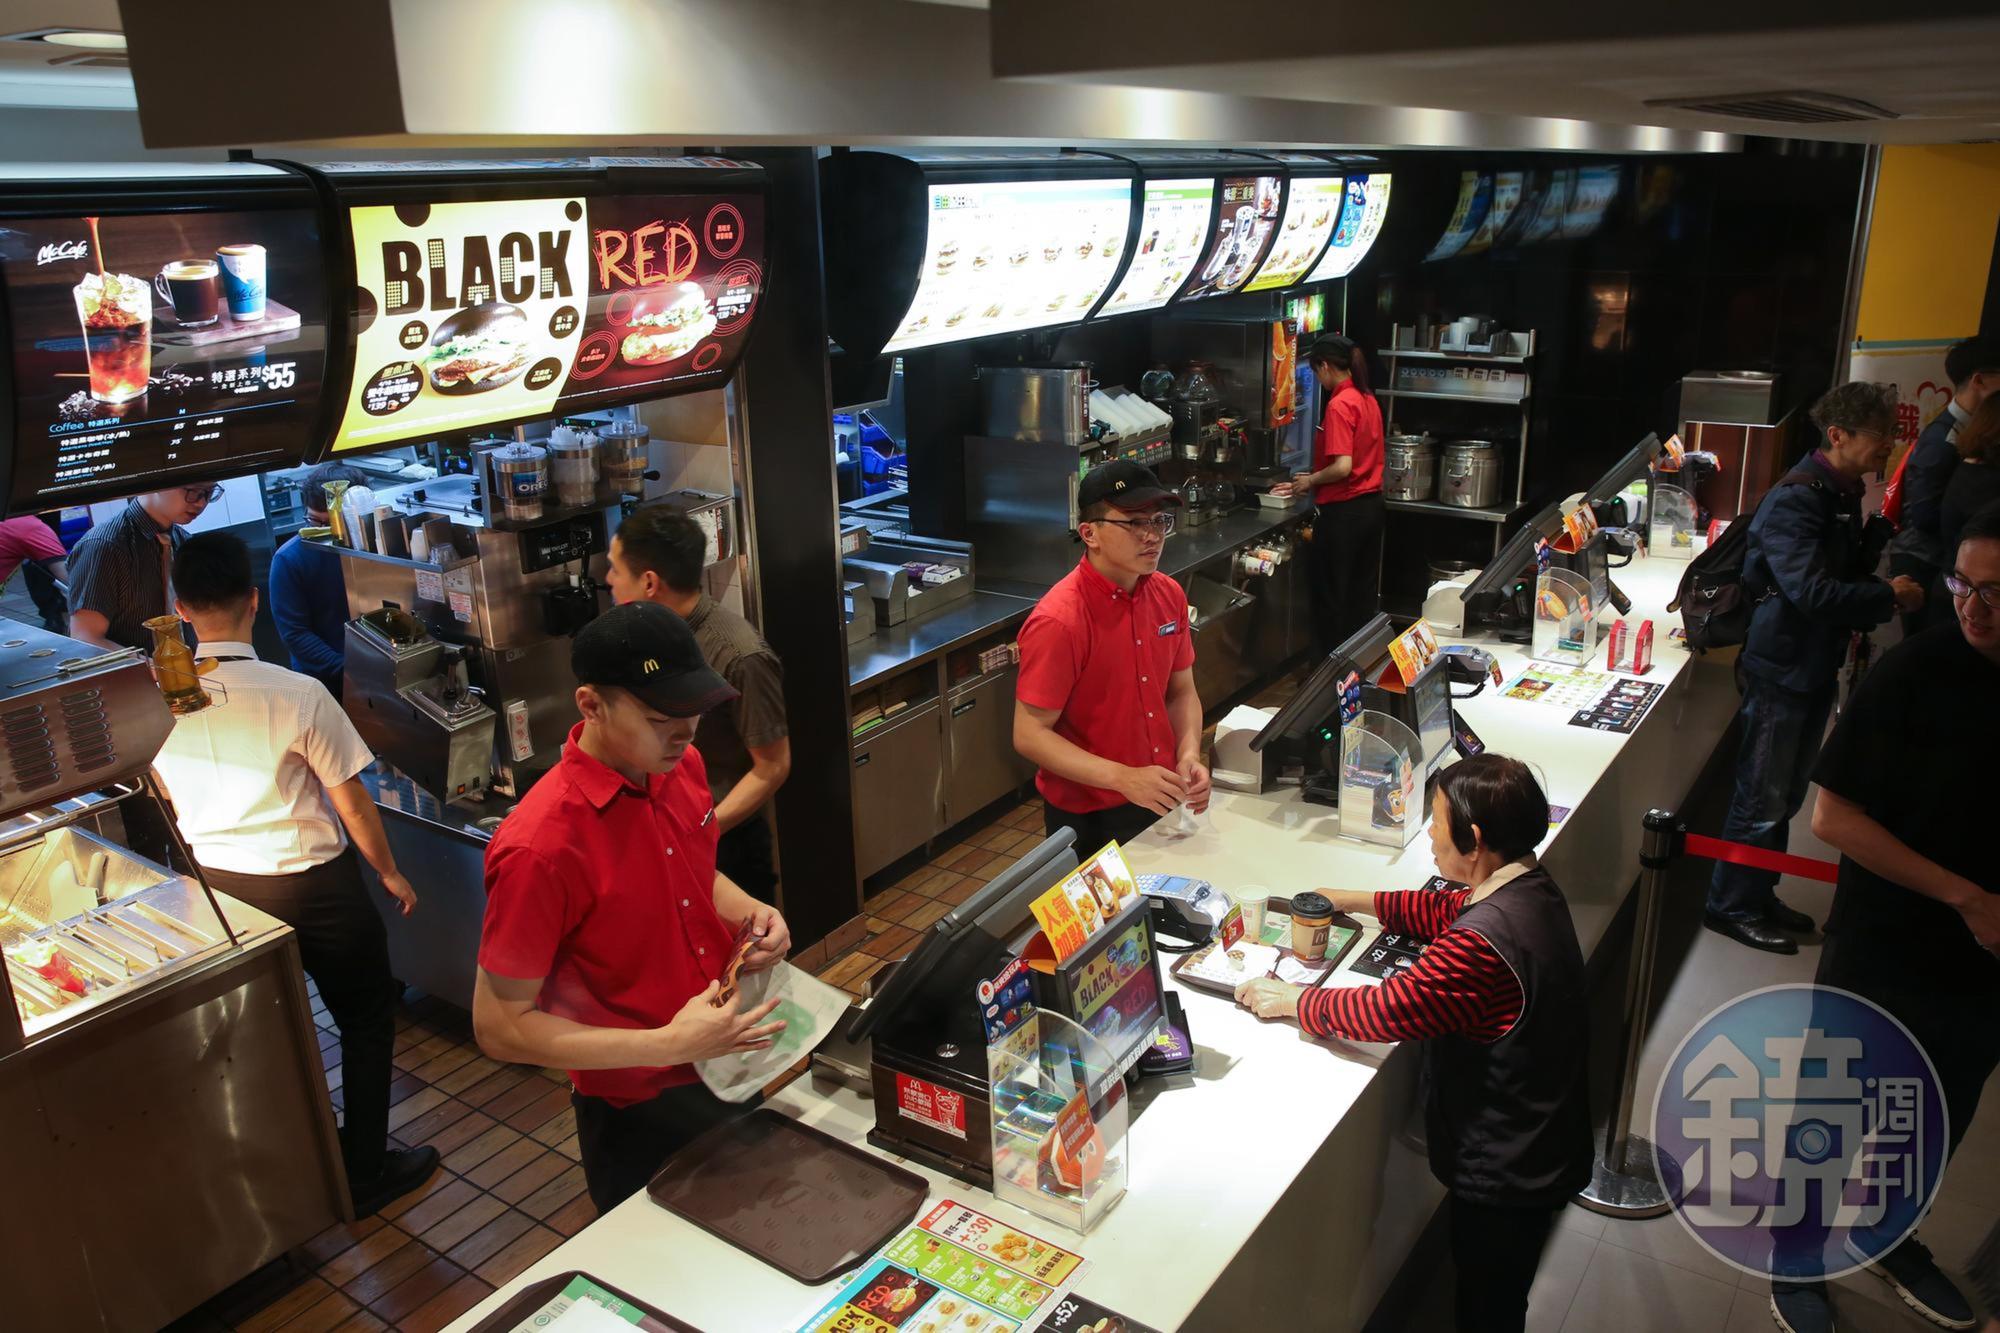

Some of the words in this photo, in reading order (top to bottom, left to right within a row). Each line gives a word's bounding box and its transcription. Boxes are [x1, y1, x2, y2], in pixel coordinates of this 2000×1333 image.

[382, 230, 573, 316] BLACK
[597, 222, 699, 291] RED
[211, 366, 261, 383] 特選系列
[261, 362, 296, 390] $55
[49, 421, 85, 433] Coffee
[1080, 965, 1114, 1010] BLACK
[857, 1285, 891, 1312] RED
